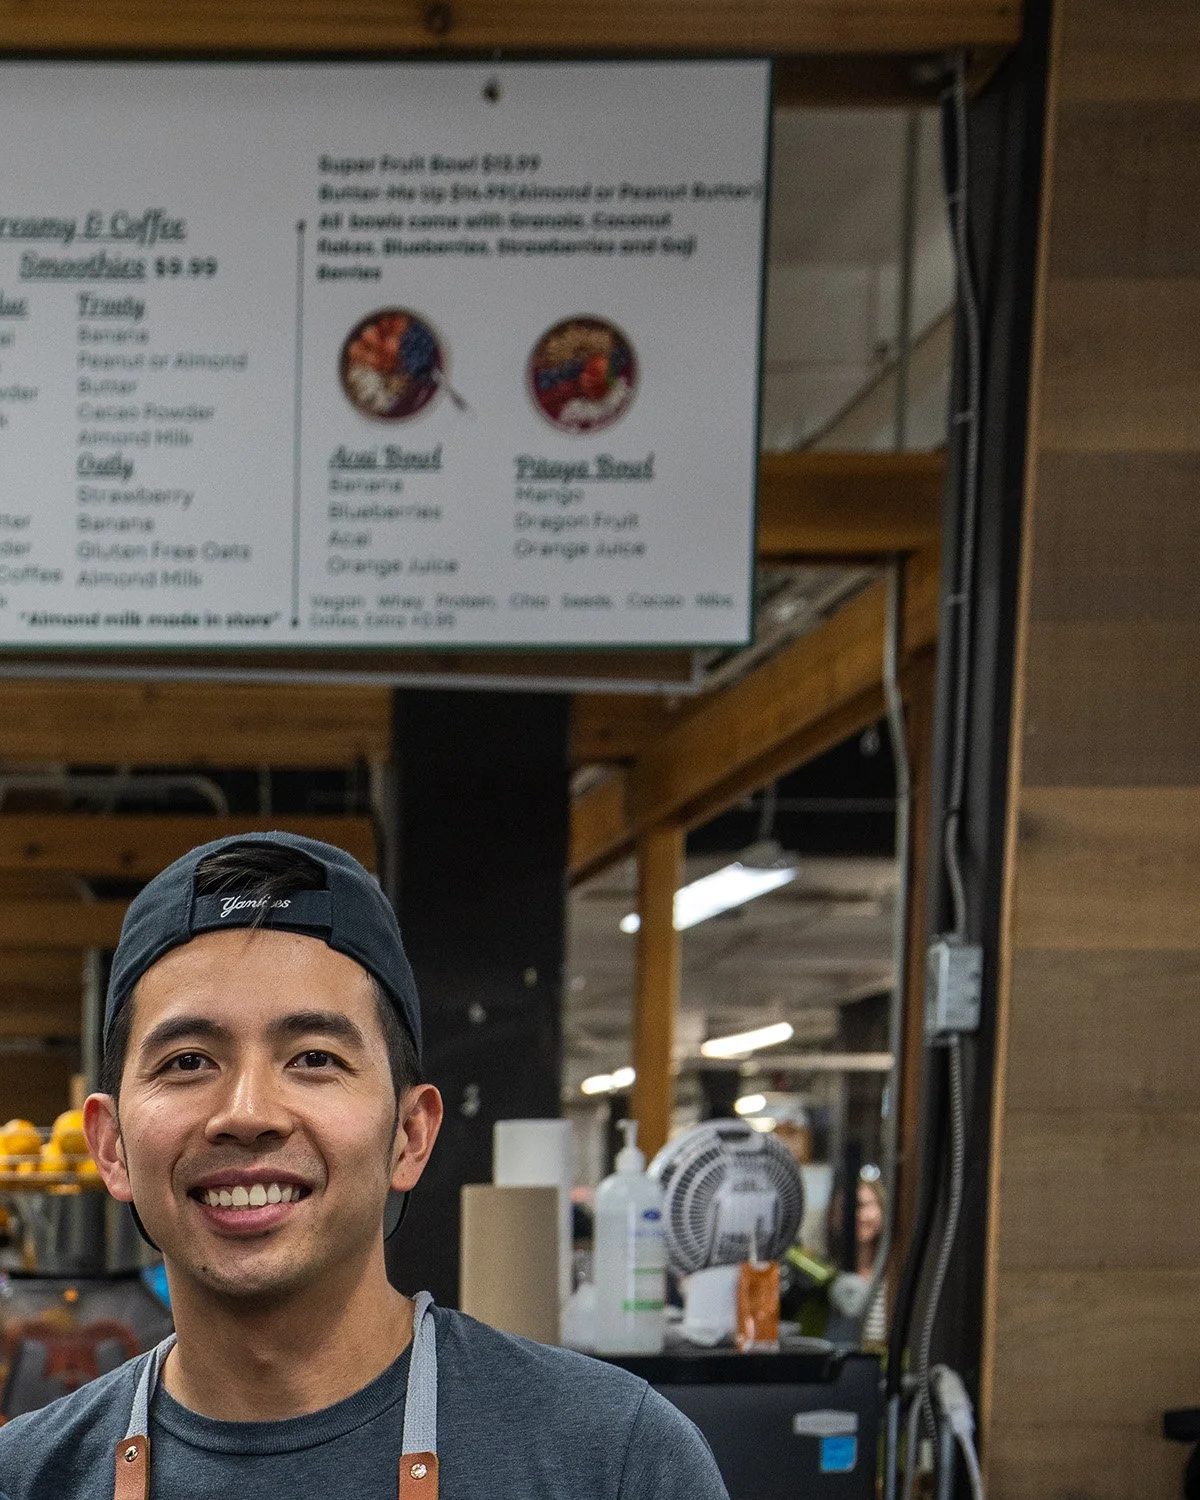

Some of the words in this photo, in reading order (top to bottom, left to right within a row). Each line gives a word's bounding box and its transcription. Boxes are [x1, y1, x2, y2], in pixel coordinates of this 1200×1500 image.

[317, 153, 376, 178] Super
[380, 153, 426, 175] Fruit
[430, 153, 477, 175] Bowl
[317, 183, 382, 203] Butter
[420, 184, 446, 207] Up
[595, 187, 615, 203] or
[619, 183, 688, 203] Peanut
[84, 208, 106, 241] &
[110, 207, 188, 248] Coffee
[317, 211, 343, 231] All
[348, 211, 403, 232] bowls
[407, 215, 461, 232] come
[464, 211, 503, 232] with
[591, 210, 673, 231] Coconut
[497, 237, 617, 258] Strawberries
[620, 237, 657, 257] and
[18, 249, 148, 283] Smoothies
[315, 263, 383, 284] Berries
[77, 325, 150, 345] Banana
[77, 351, 146, 370] Peanut
[149, 354, 169, 370] or
[173, 353, 248, 372] Almond
[77, 377, 138, 396] Butter
[77, 429, 150, 448] Almond
[154, 429, 193, 447] Milk
[76, 450, 135, 484] Oatly
[382, 443, 444, 472] Bowl
[513, 453, 591, 485] Pitaya
[594, 450, 656, 481] Bowl
[327, 475, 404, 495] Banana
[77, 485, 195, 511] Strawberry
[514, 486, 585, 508] Mango
[327, 502, 443, 522] Blueberries
[76, 513, 155, 534] Banana
[513, 511, 588, 536] Dragon
[592, 511, 640, 532] Fruit
[76, 541, 147, 562] Gluten
[151, 542, 197, 561] Free
[201, 542, 252, 562] Oats
[513, 538, 590, 563] Orange
[593, 541, 647, 559] Juice
[326, 555, 403, 579] Orange
[408, 558, 460, 577] Juice
[76, 570, 157, 590] Almond
[160, 570, 203, 588] Milk
[104, 611, 143, 628] milk
[147, 611, 200, 628] made
[204, 611, 222, 627] in
